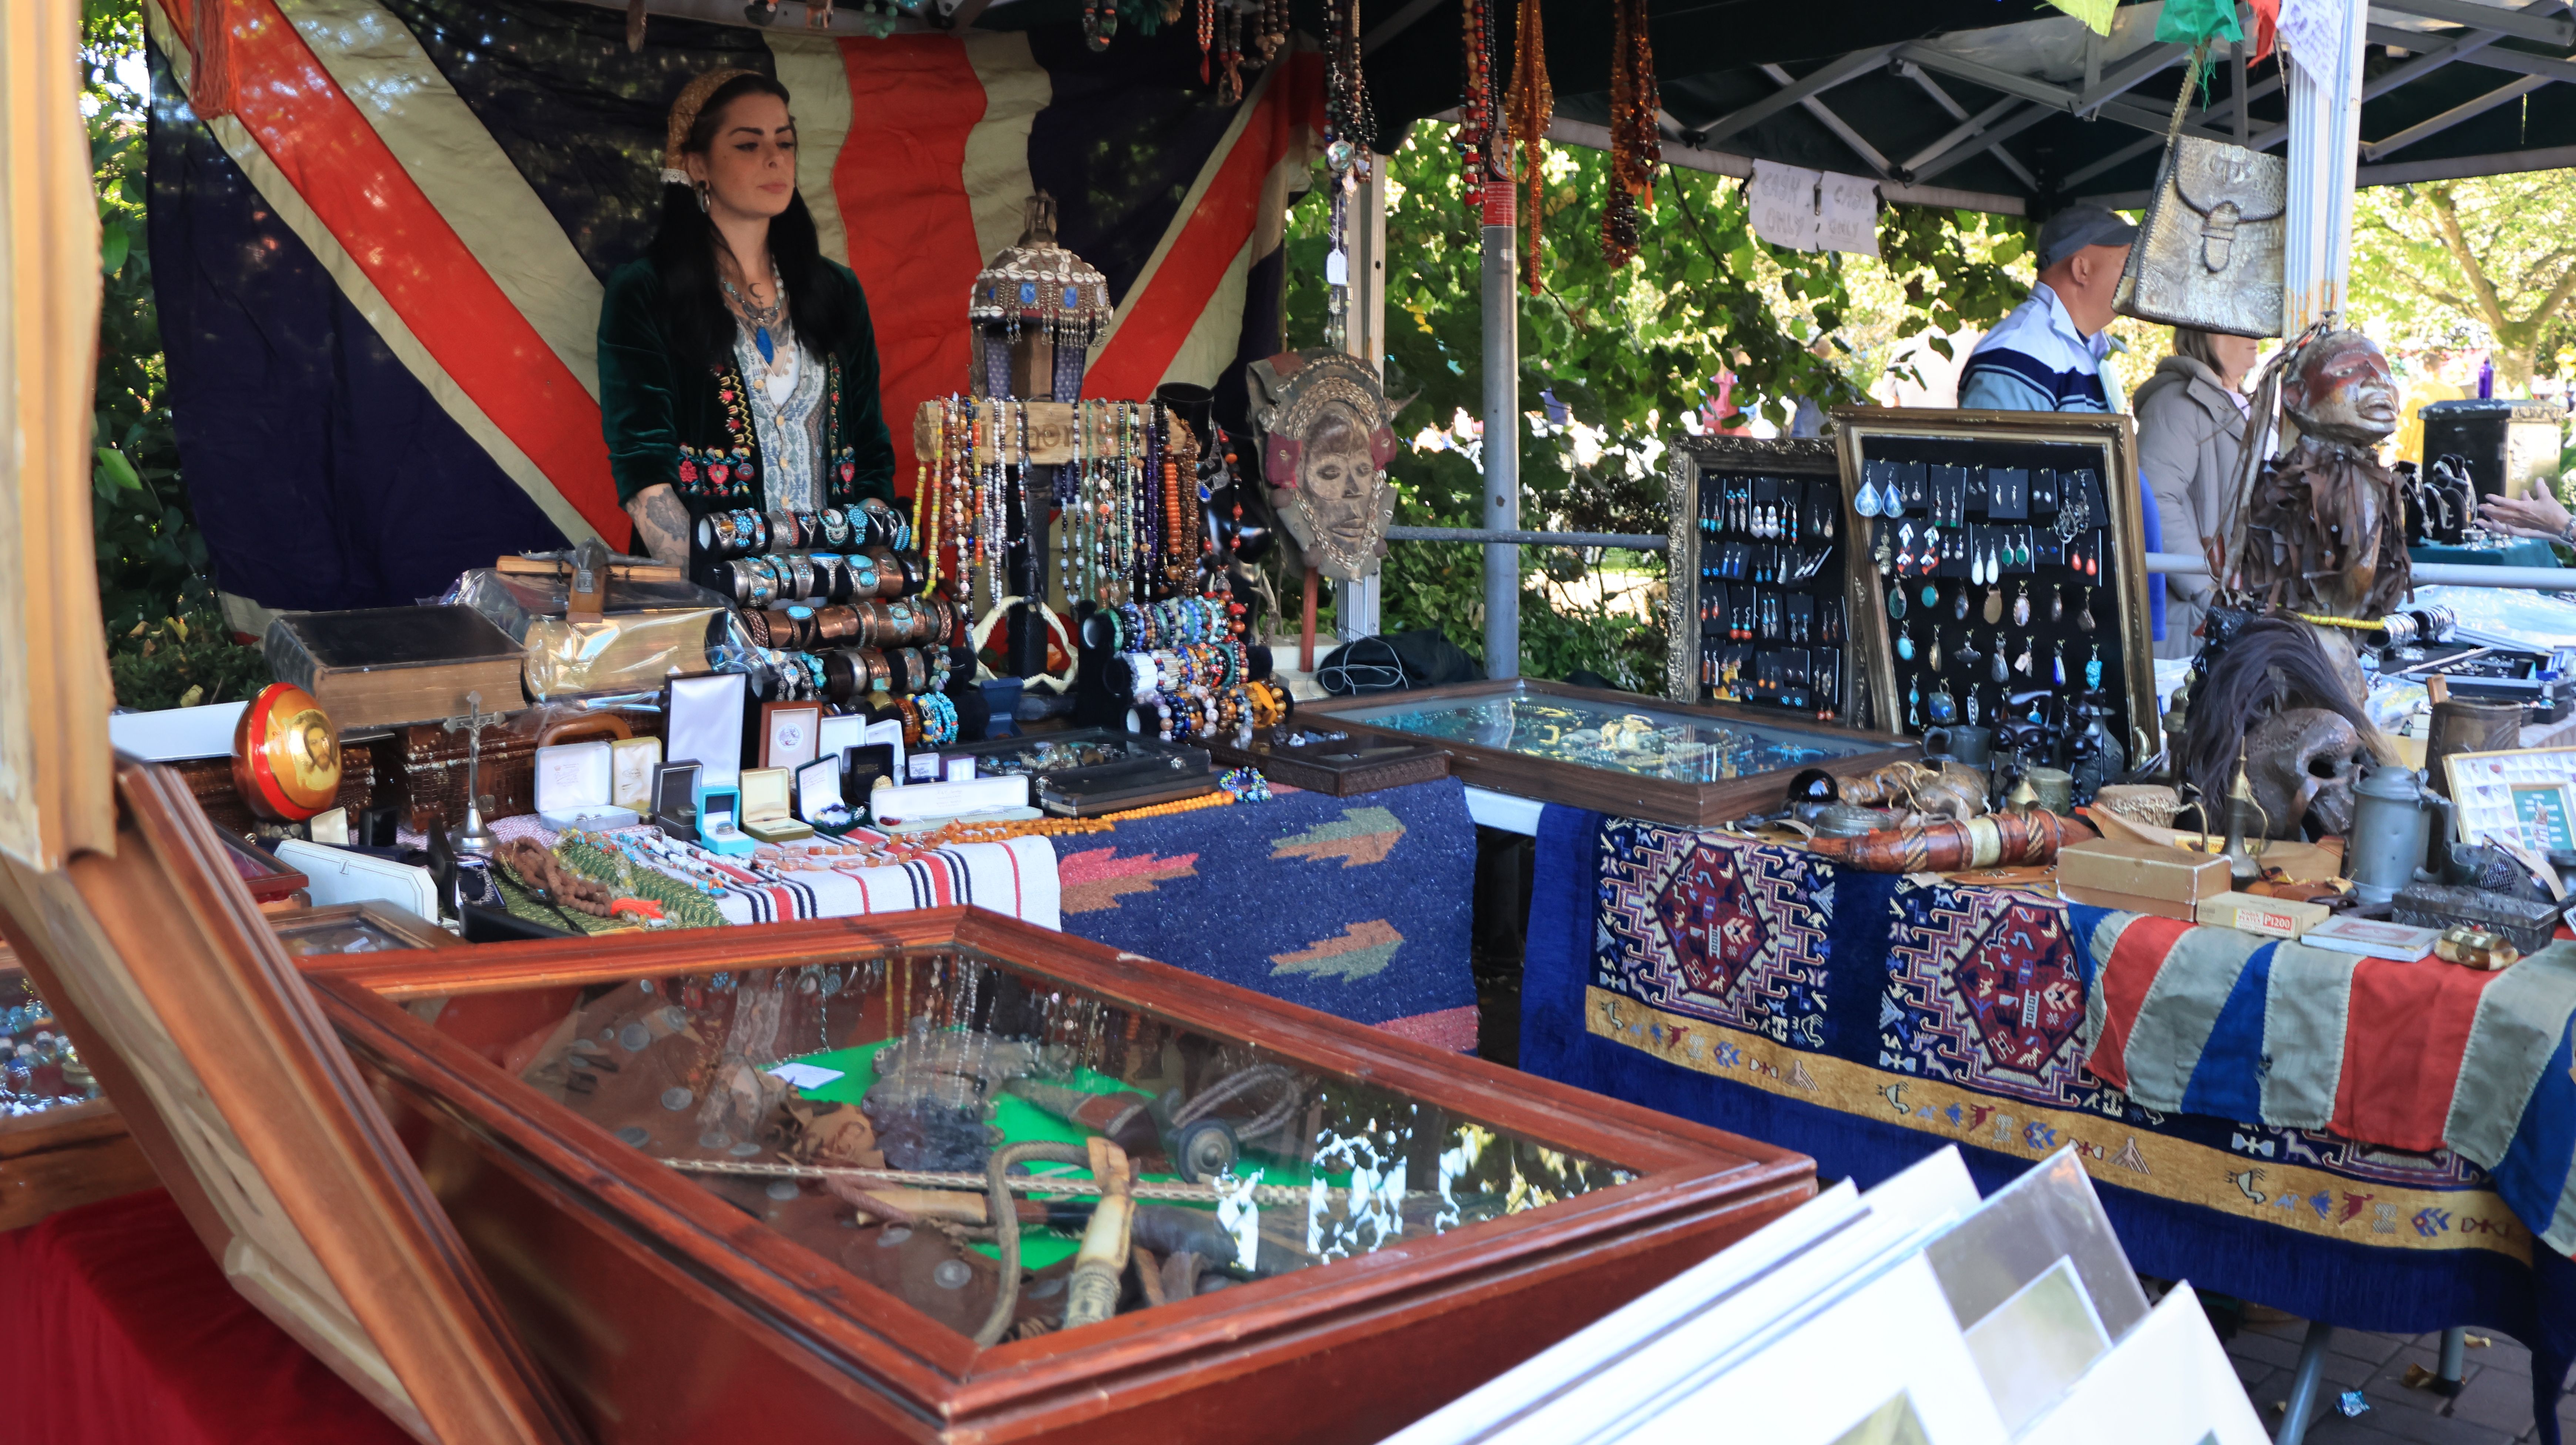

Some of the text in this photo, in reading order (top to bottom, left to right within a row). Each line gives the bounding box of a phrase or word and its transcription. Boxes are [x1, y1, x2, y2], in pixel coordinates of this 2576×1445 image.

[1761, 172, 1801, 208] CASH
[1765, 207, 1805, 237] ONLY
[1829, 218, 1859, 238] ONLY
